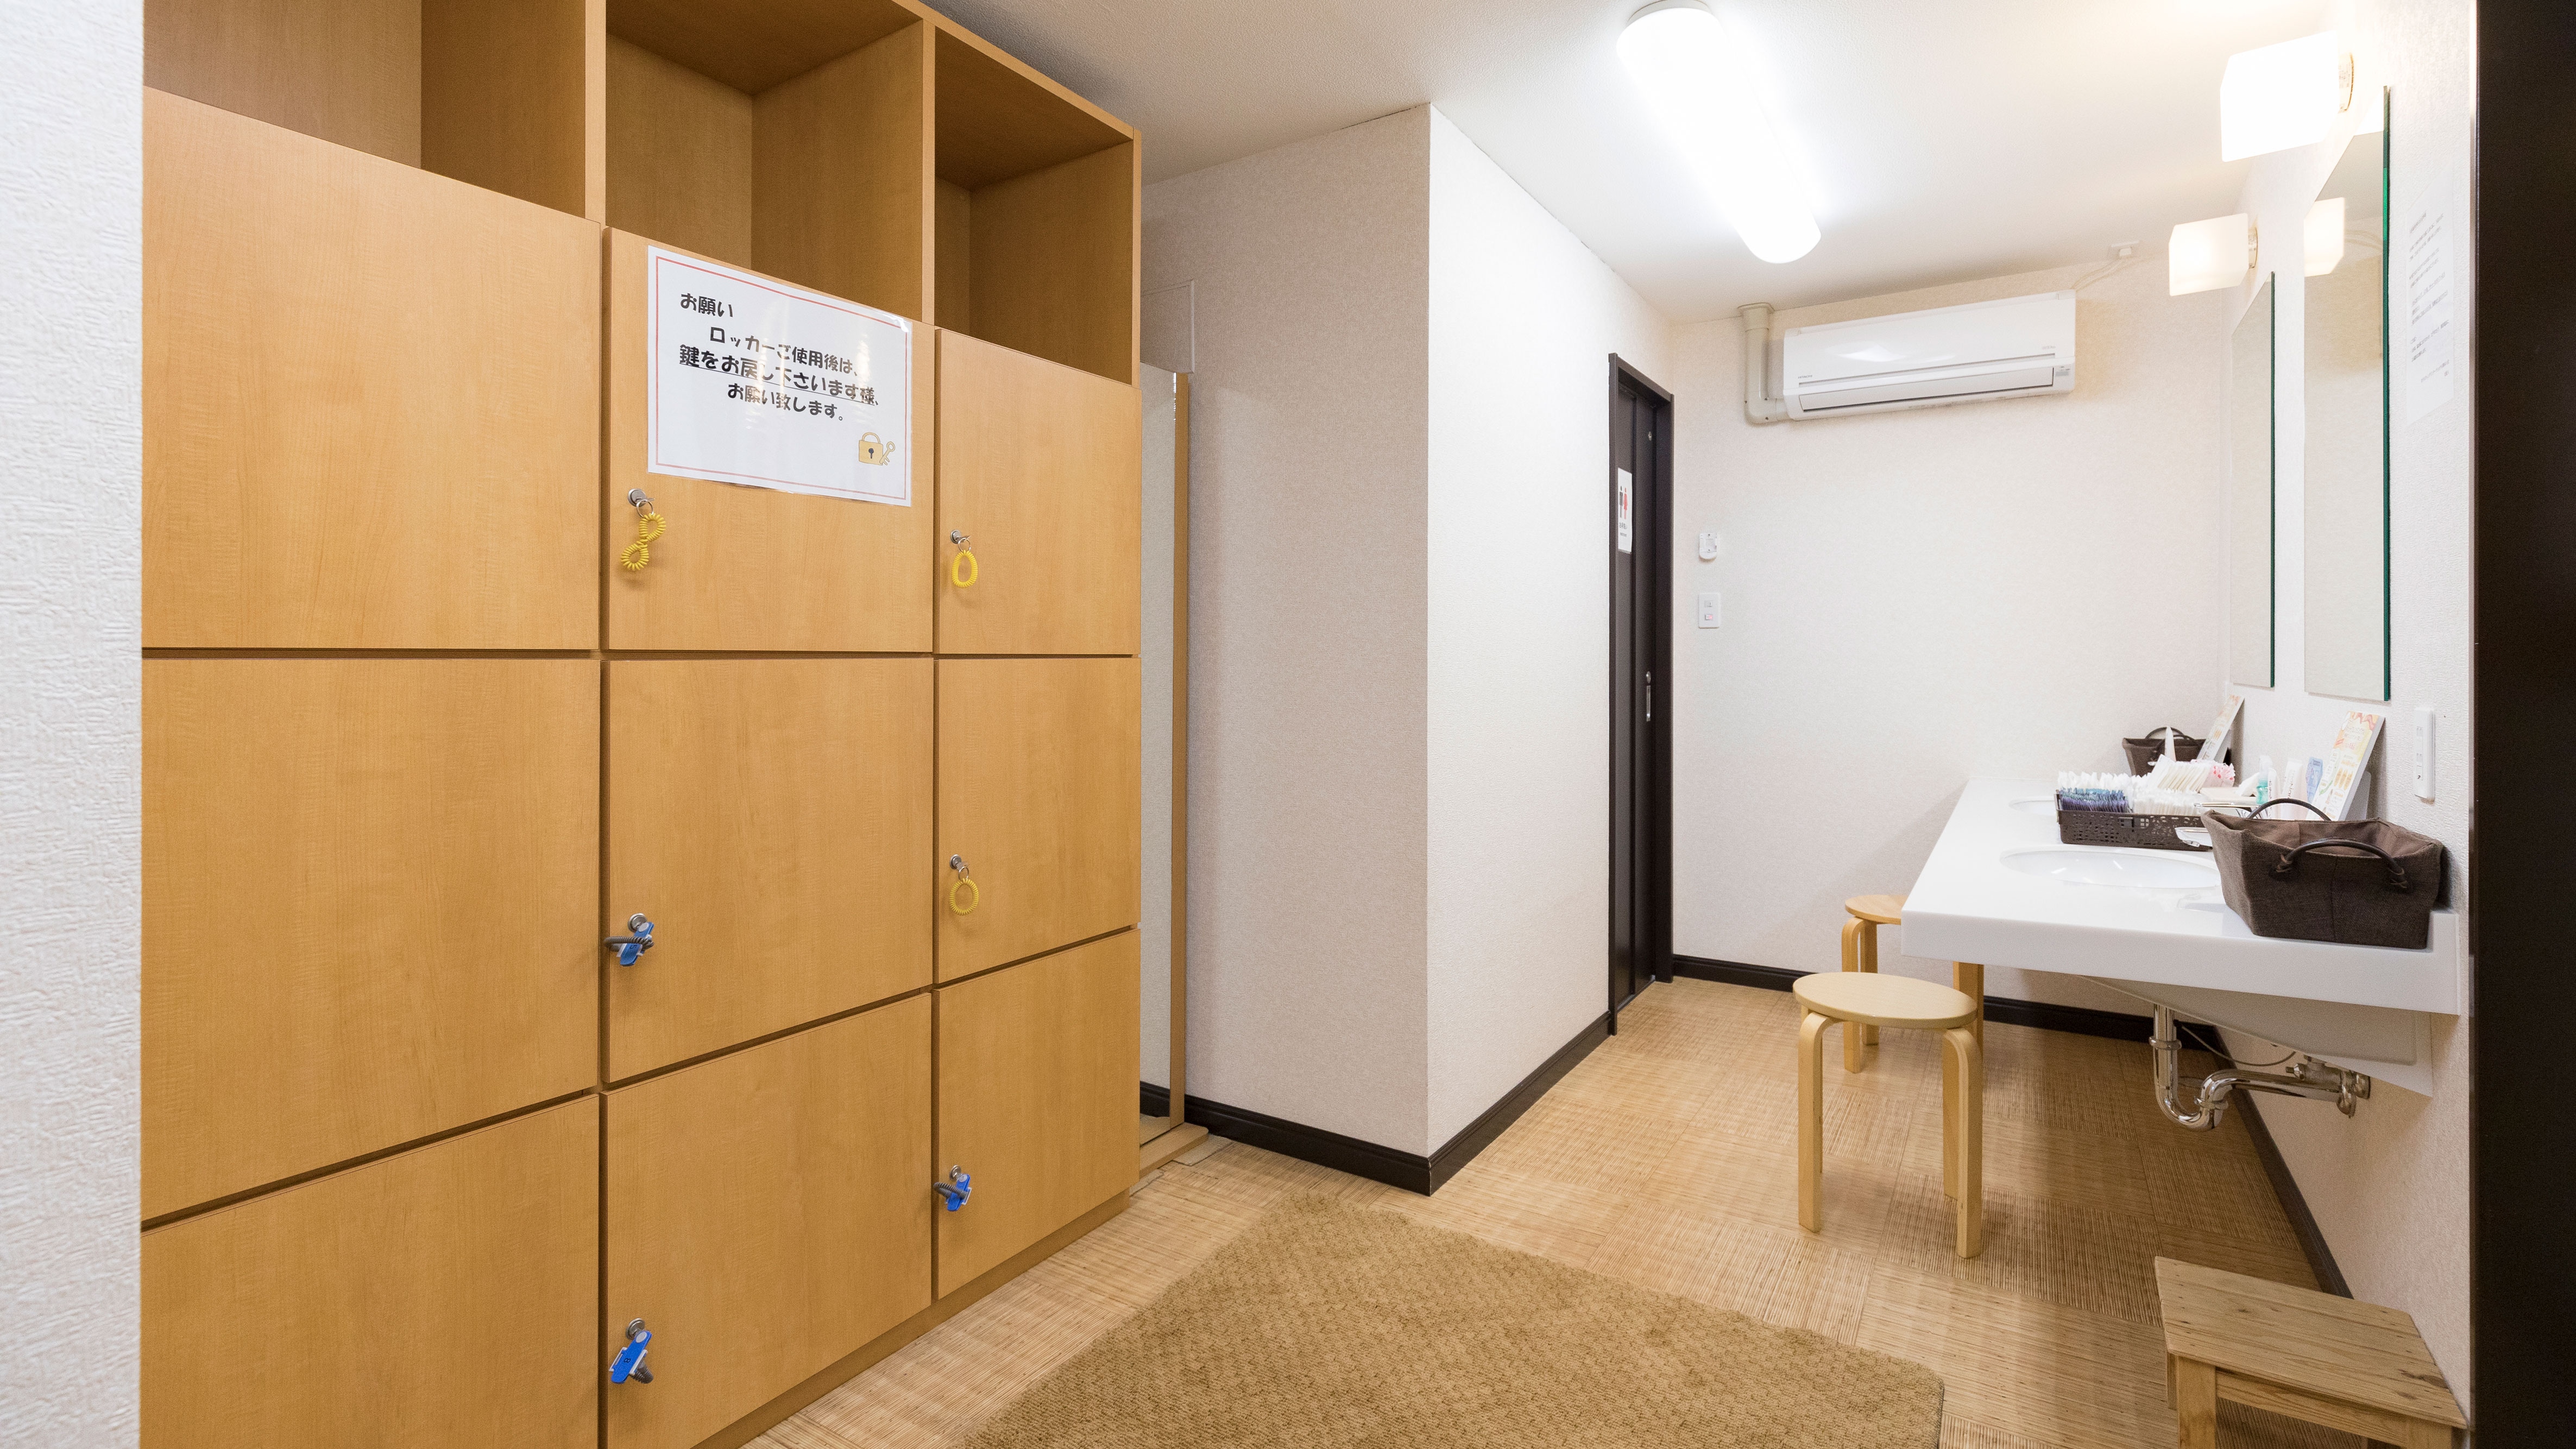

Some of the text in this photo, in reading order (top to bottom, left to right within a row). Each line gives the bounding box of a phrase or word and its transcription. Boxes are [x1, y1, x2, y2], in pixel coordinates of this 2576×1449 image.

[681, 293, 733, 317] お願い
[710, 326, 858, 376] ロッカーご使用後は、
[728, 383, 843, 420] お願い致します。
